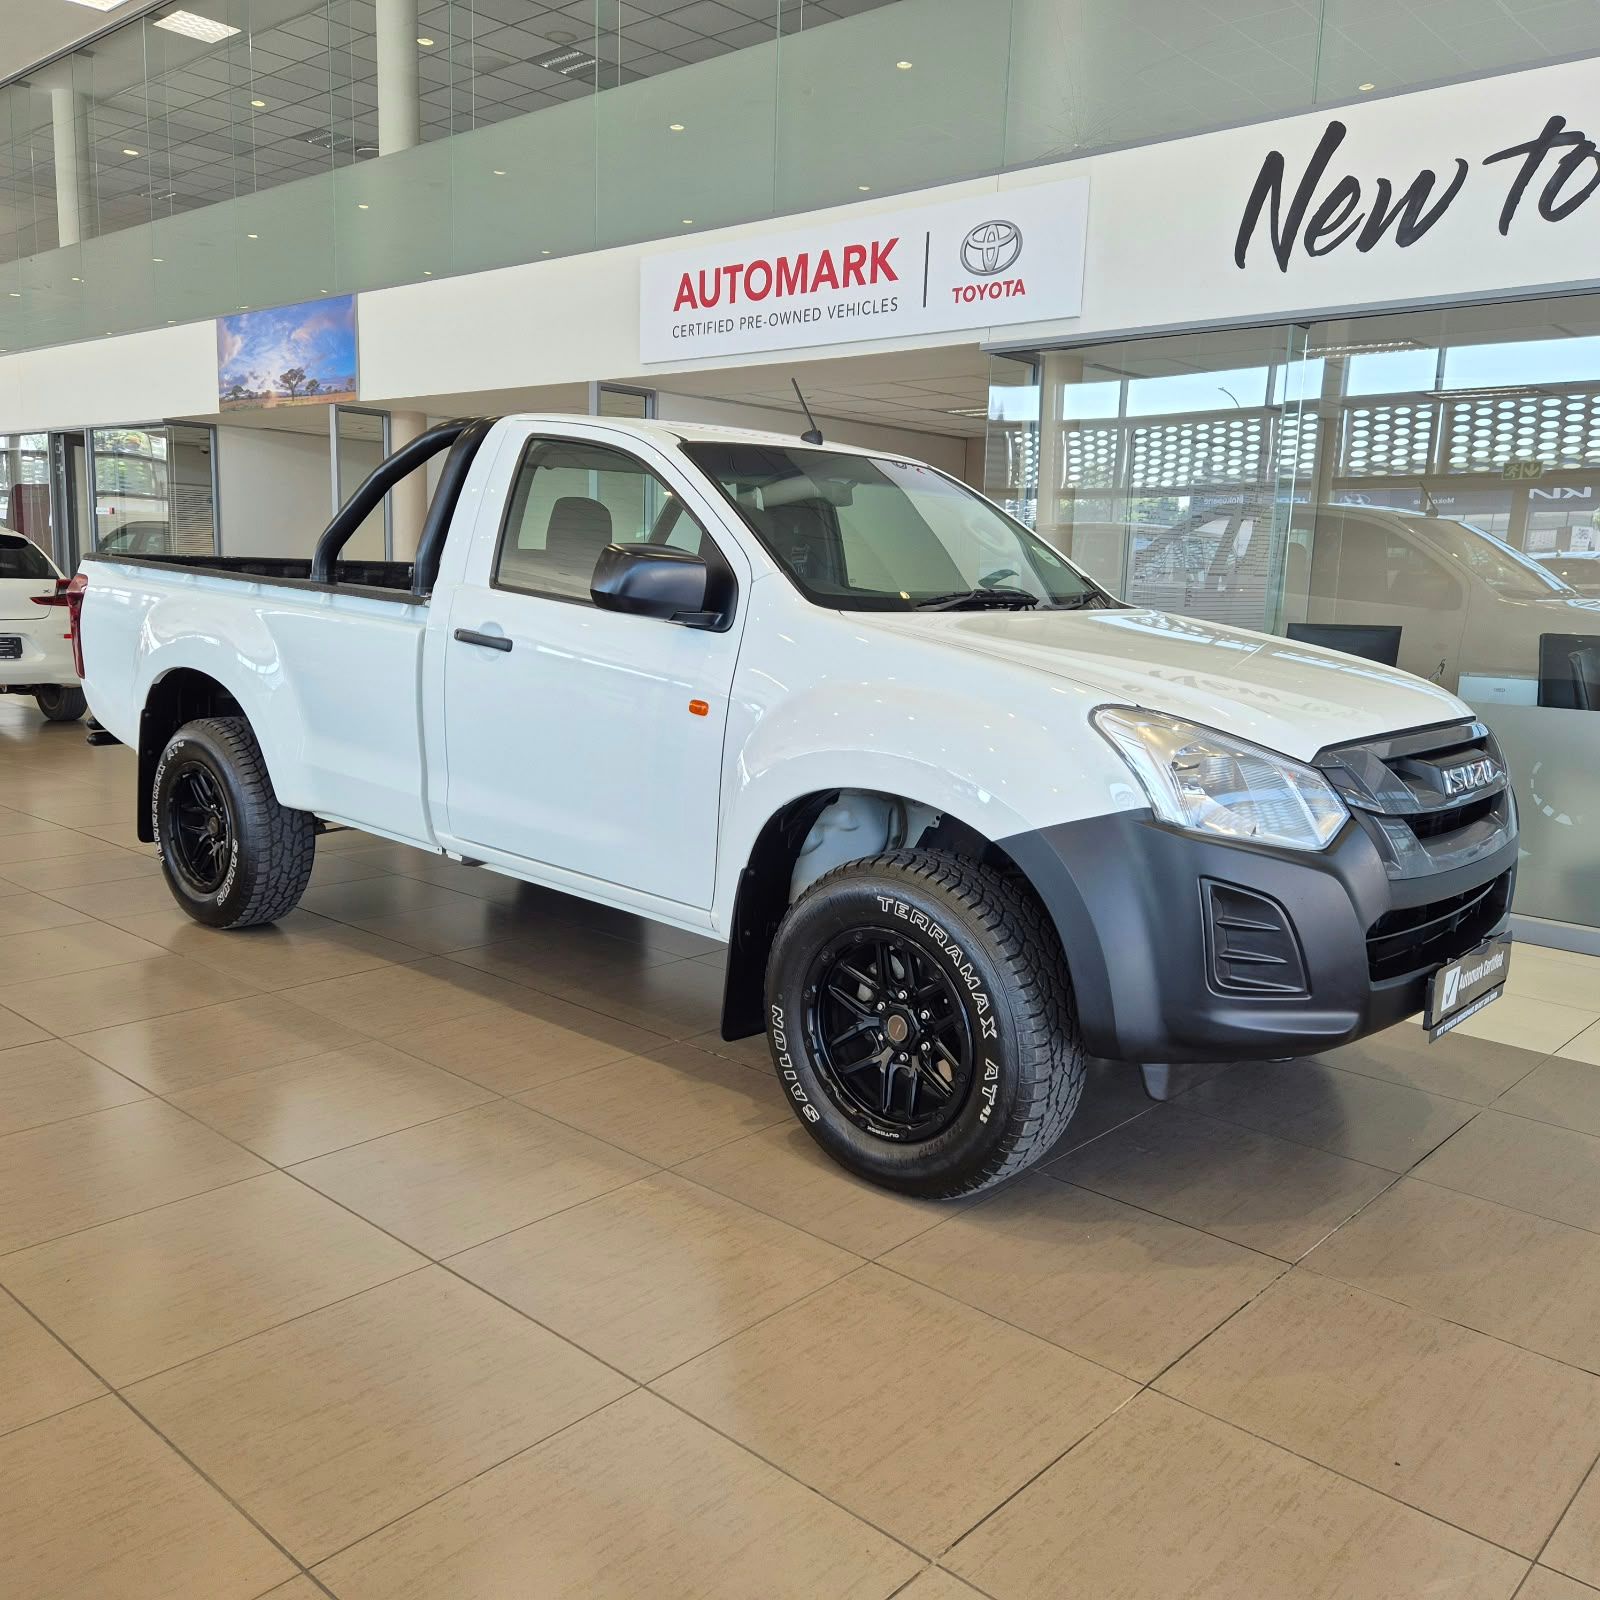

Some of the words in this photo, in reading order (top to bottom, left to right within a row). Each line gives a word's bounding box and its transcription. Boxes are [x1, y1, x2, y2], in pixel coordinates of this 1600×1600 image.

[1234, 120, 1469, 273] New
[673, 237, 899, 312] AUTOMARK
[952, 278, 1027, 304] TOYOTA
[672, 318, 735, 339] CERTIFIED
[739, 307, 822, 330] PRE-OWNED
[827, 296, 899, 320] VEHICLES
[1442, 759, 1495, 796] ISUZU
[877, 896, 998, 1040] TERRAMAX
[772, 1005, 820, 1123] SAILUN
